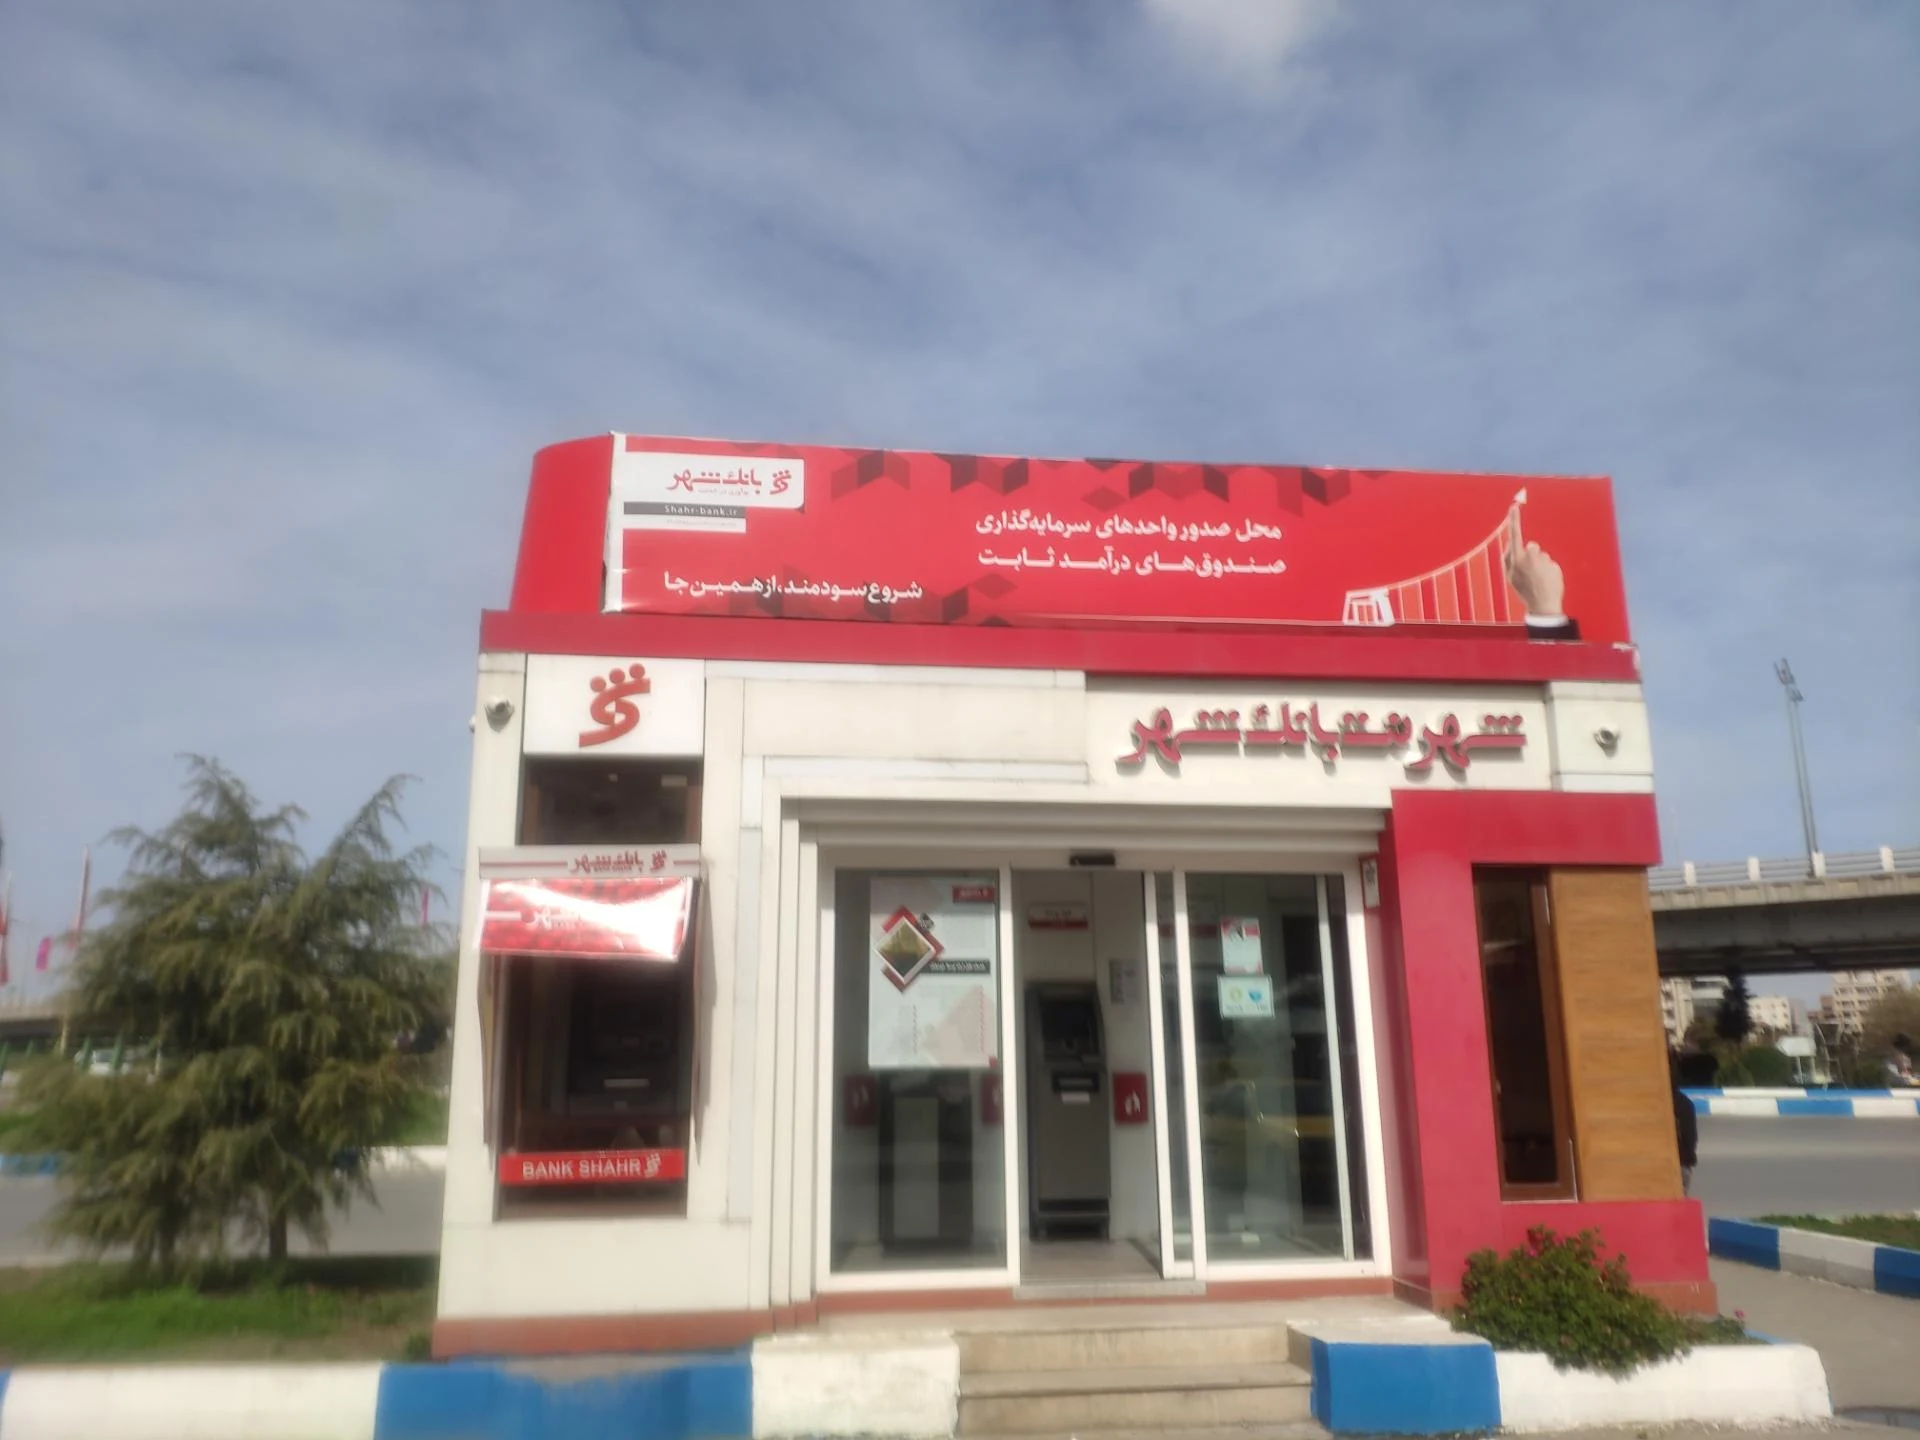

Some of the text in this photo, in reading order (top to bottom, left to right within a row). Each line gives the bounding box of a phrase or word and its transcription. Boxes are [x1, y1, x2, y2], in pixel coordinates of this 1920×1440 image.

[665, 468, 721, 493] شهر
[1096, 513, 1178, 541] واحدهای
[1179, 519, 1231, 542] صدور
[1235, 518, 1283, 542] محل
[977, 545, 1056, 573] ثابت
[1059, 545, 1131, 575] درآمد
[867, 580, 923, 604] شروع
[1114, 706, 1242, 765] شهر
[521, 1155, 642, 1182] BANK SHAHR
